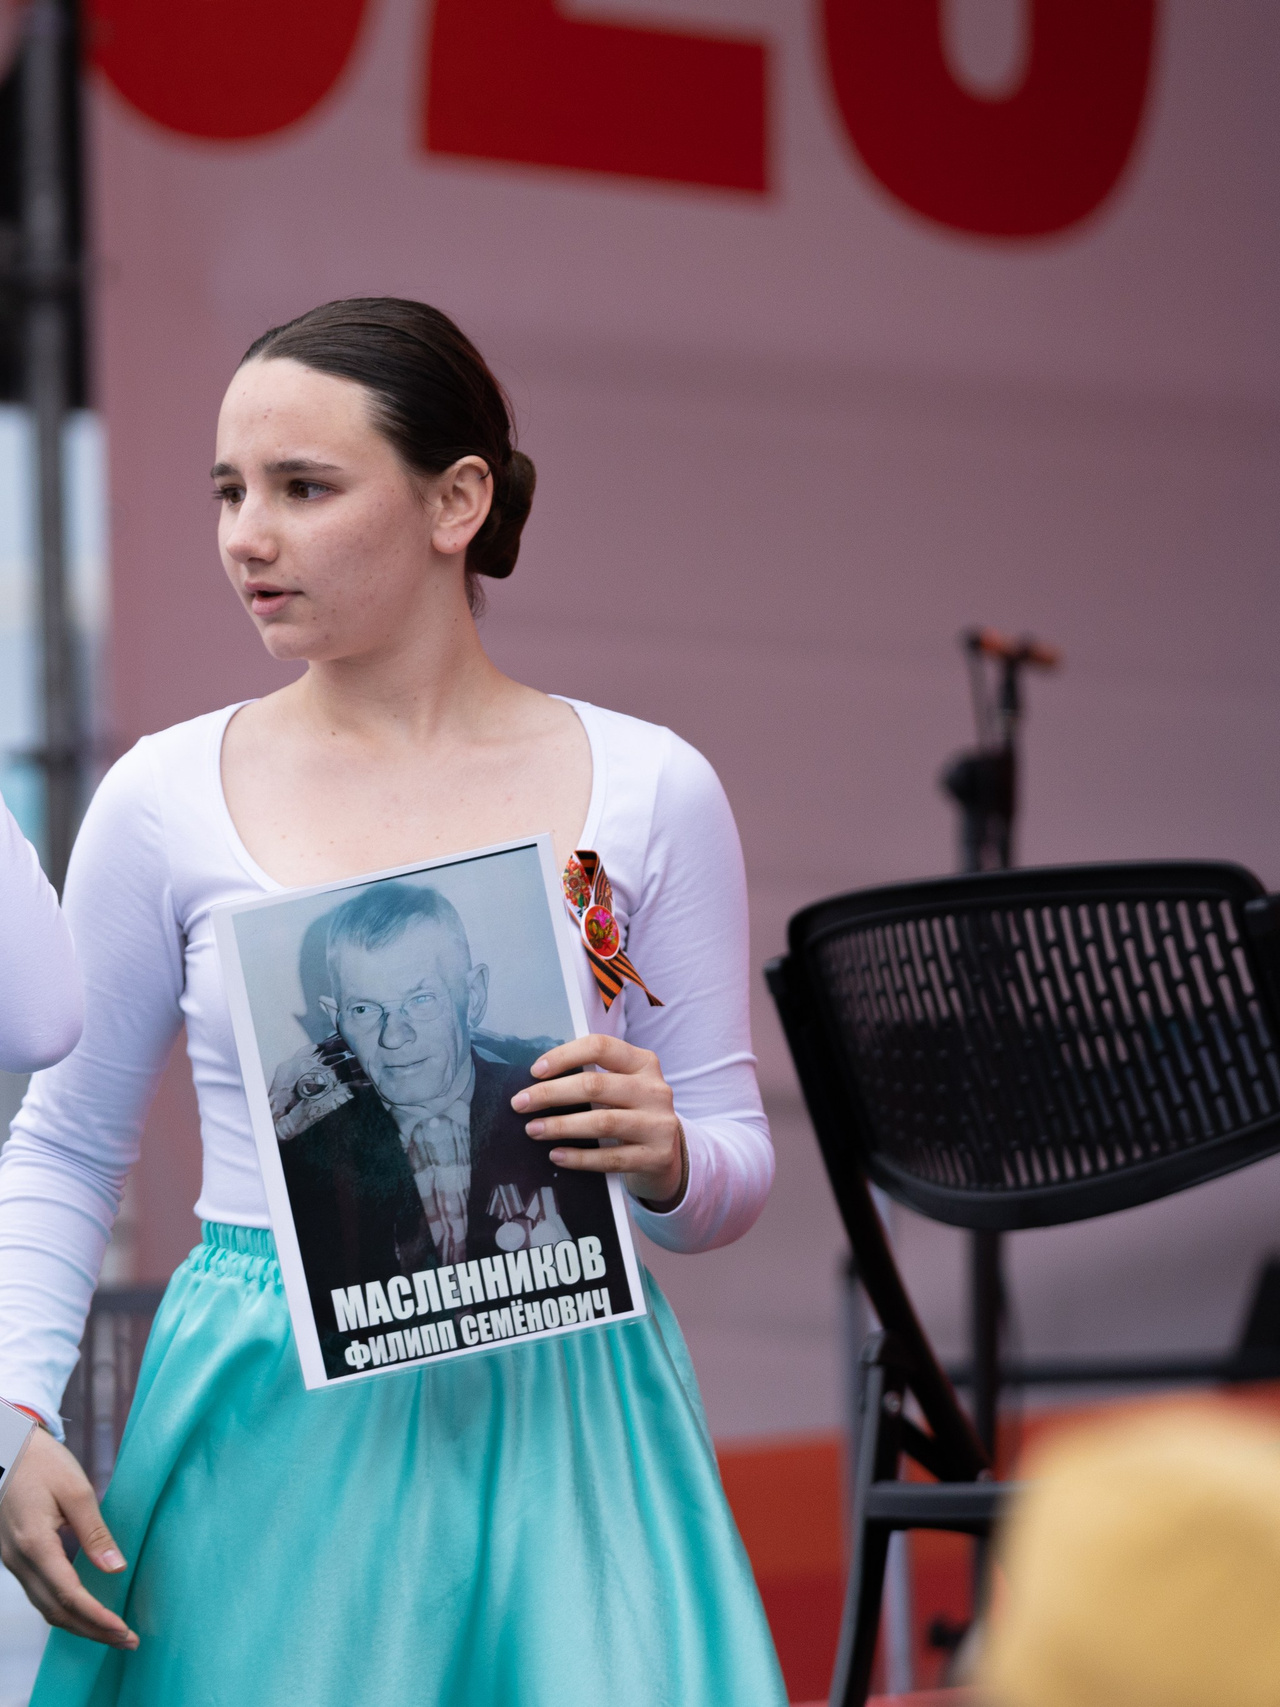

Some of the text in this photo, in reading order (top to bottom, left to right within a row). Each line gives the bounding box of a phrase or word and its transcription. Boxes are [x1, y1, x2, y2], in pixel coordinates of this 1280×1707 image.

[331, 1236, 606, 1332] МАСЛЕННИКОВ
[344, 1288, 612, 1370] ФИЛИПП СЕМЁНОВИЧ
